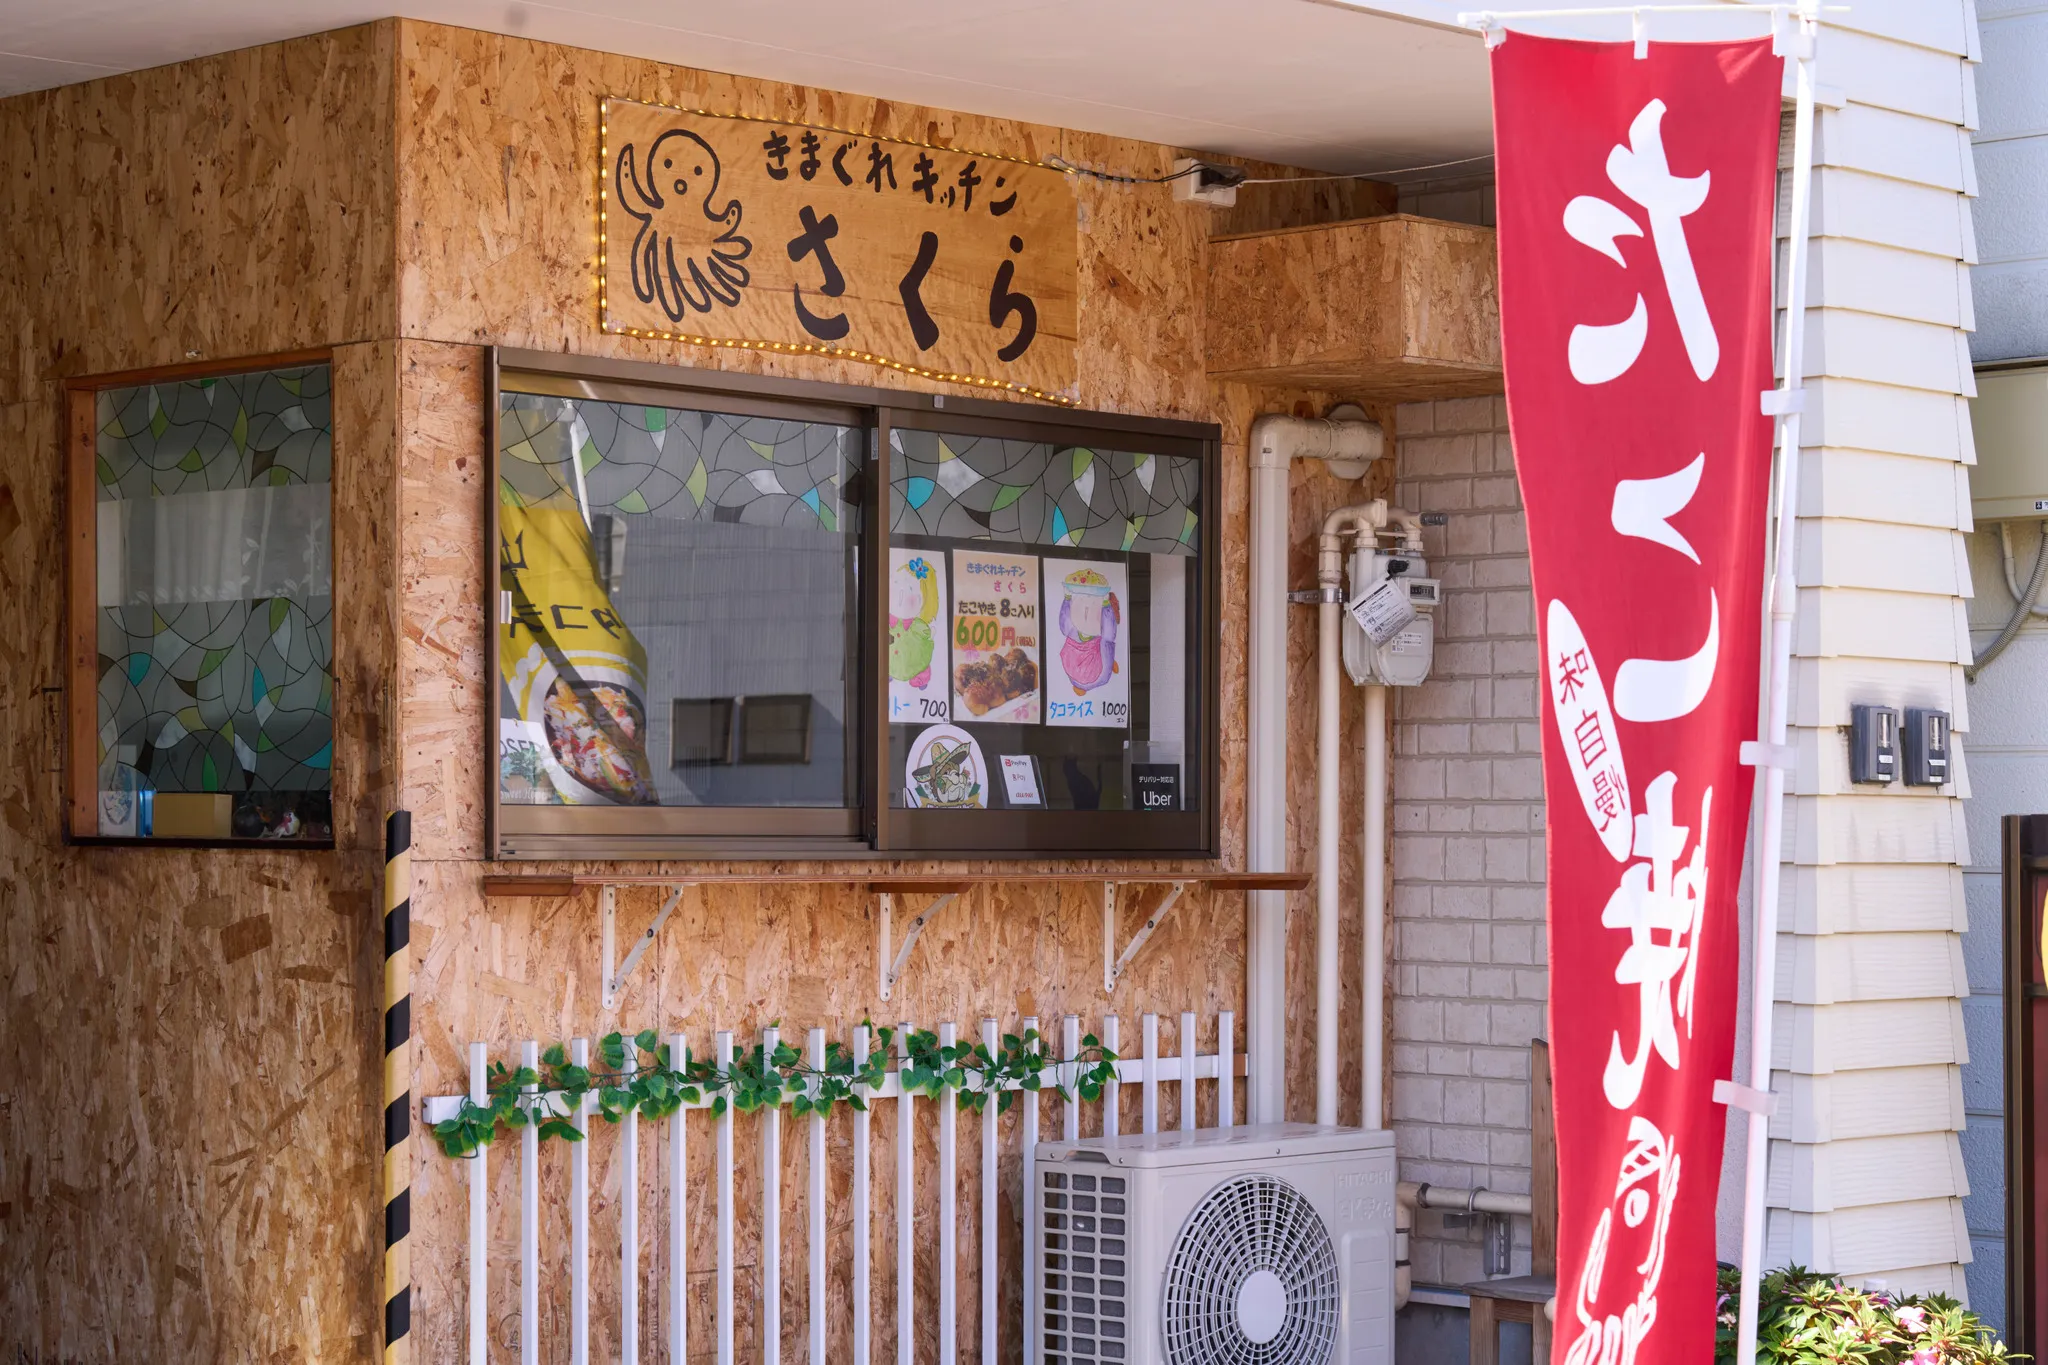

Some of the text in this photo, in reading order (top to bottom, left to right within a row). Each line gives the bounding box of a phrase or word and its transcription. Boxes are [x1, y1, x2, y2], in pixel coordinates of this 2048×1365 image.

[763, 130, 1017, 216] きまぐれキッチン
[786, 205, 1037, 362] さくら
[966, 562, 1026, 577] きまぐれキッチン
[994, 580, 1027, 594] さくら
[958, 598, 1035, 619] たこやき 8こ入り
[919, 698, 948, 719] 700
[1050, 700, 1127, 719] タコライス 1000
[1143, 791, 1172, 806] Uber
[1338, 1169, 1392, 1187] HITACHI
